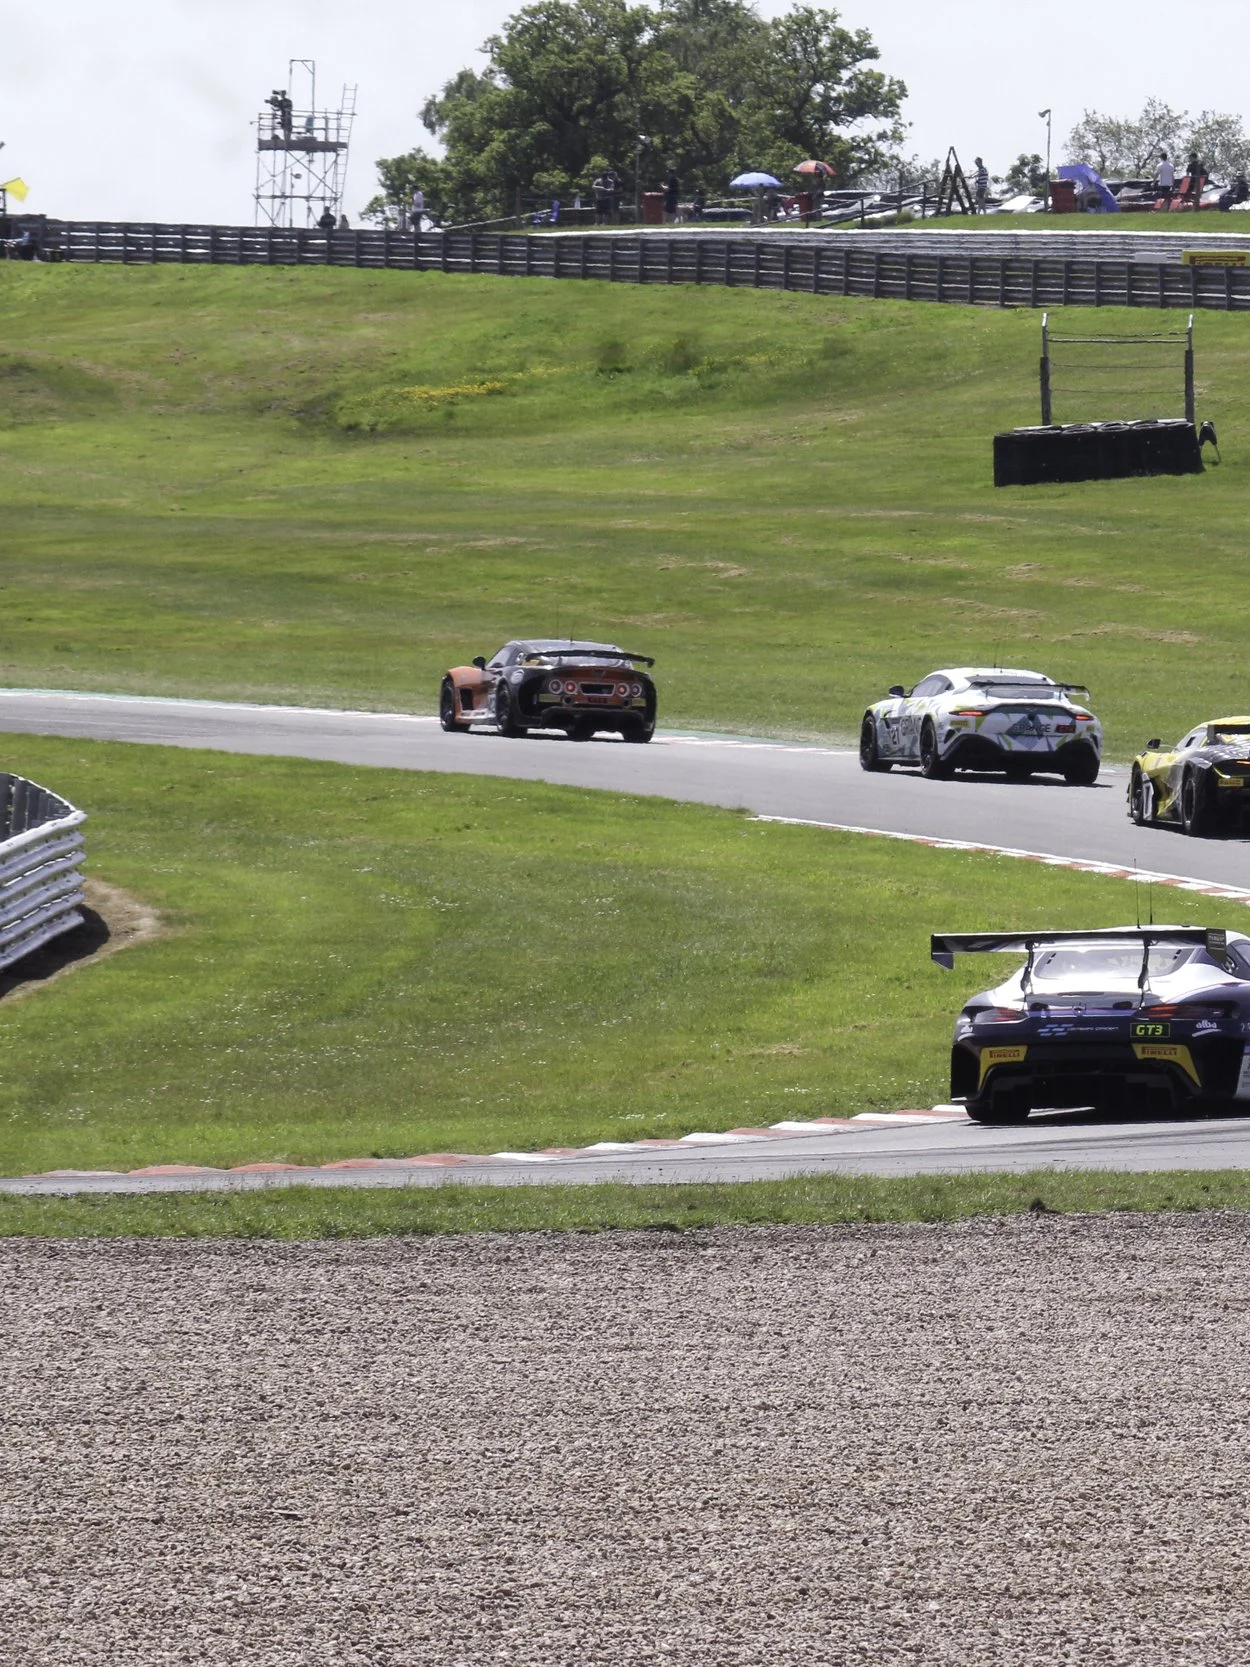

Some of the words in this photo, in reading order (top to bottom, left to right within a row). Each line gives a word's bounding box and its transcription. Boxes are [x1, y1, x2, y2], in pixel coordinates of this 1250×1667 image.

[1195, 1019, 1218, 1029] alba
[1135, 1024, 1164, 1036] GT3
[988, 1049, 1020, 1059] PIRELLI
[1140, 1046, 1178, 1056] PIRELLI
